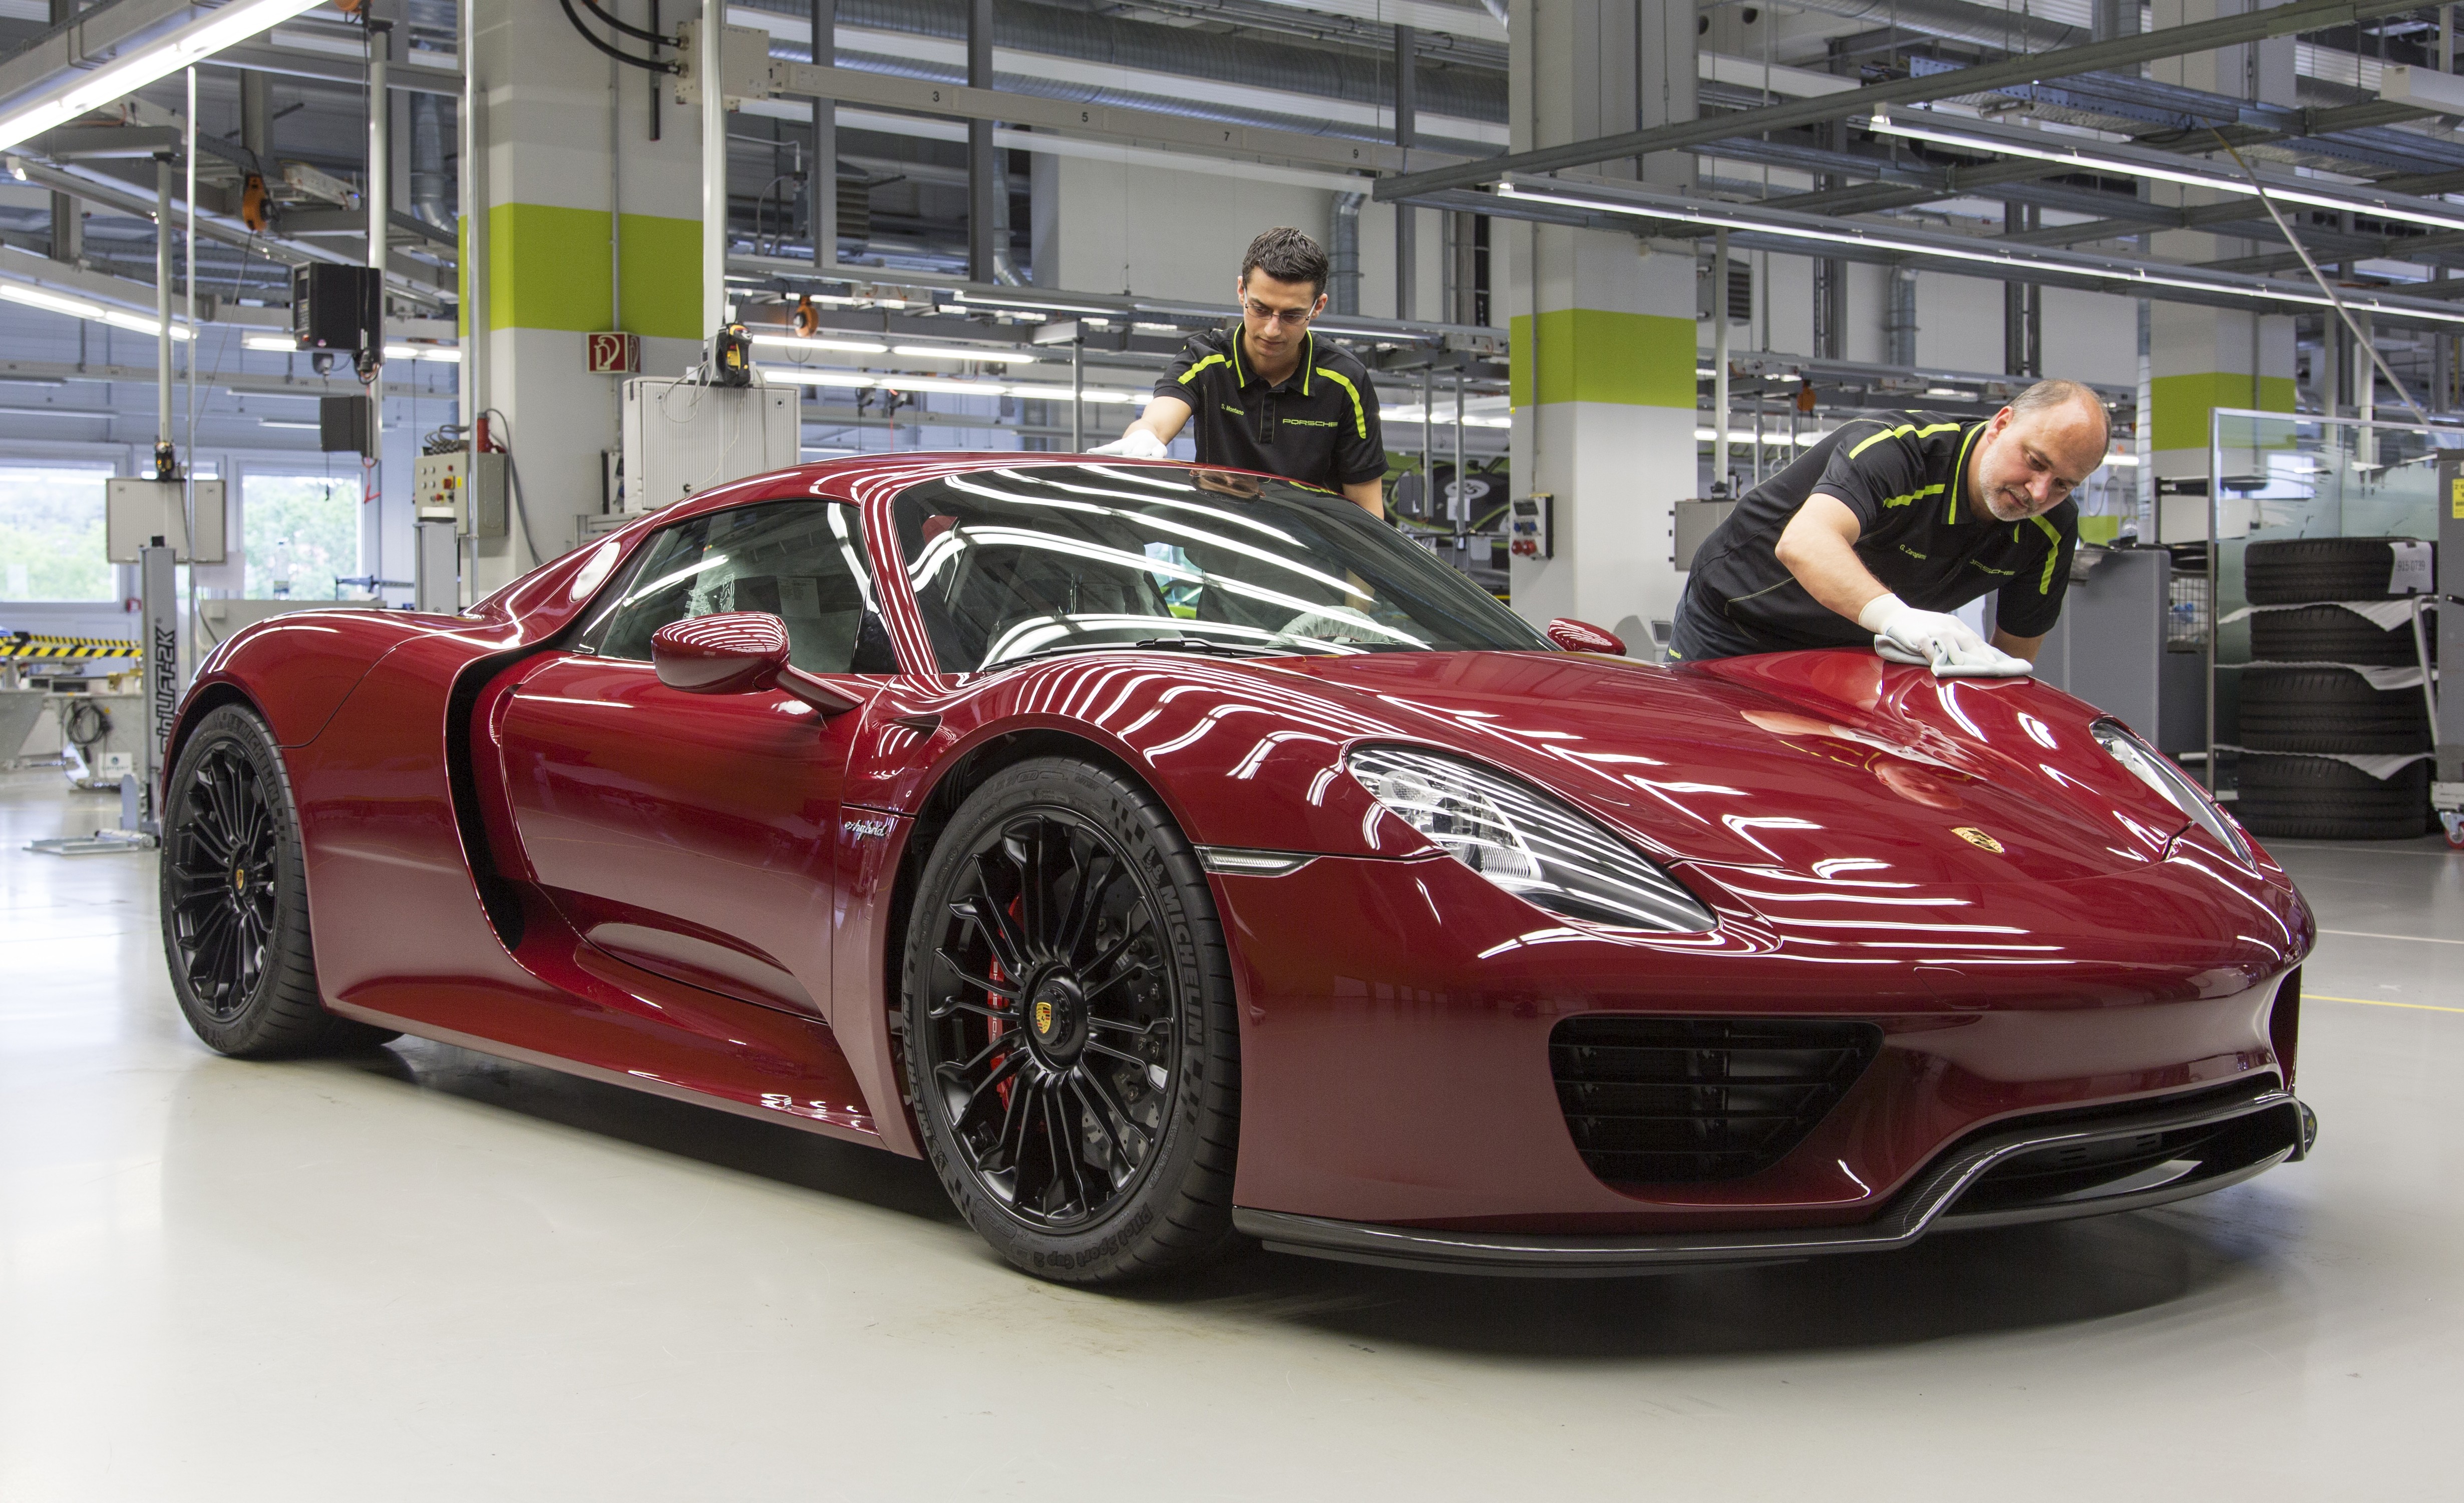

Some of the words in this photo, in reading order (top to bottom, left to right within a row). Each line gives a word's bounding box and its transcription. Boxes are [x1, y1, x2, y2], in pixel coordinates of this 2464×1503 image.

[932, 91, 940, 102] 3
[1082, 112, 1089, 122] 5
[1224, 131, 1230, 141] 7
[1353, 149, 1359, 159] 9
[1226, 405, 1244, 416] Montano
[1282, 419, 1338, 427] PORSCHE
[1159, 885, 1202, 1045] MICHELIN
[903, 994, 932, 1138] MICHELIN
[1076, 1235, 1119, 1268] Sport
[1033, 1252, 1045, 1268] 2
[1046, 1251, 1075, 1270] Cup
